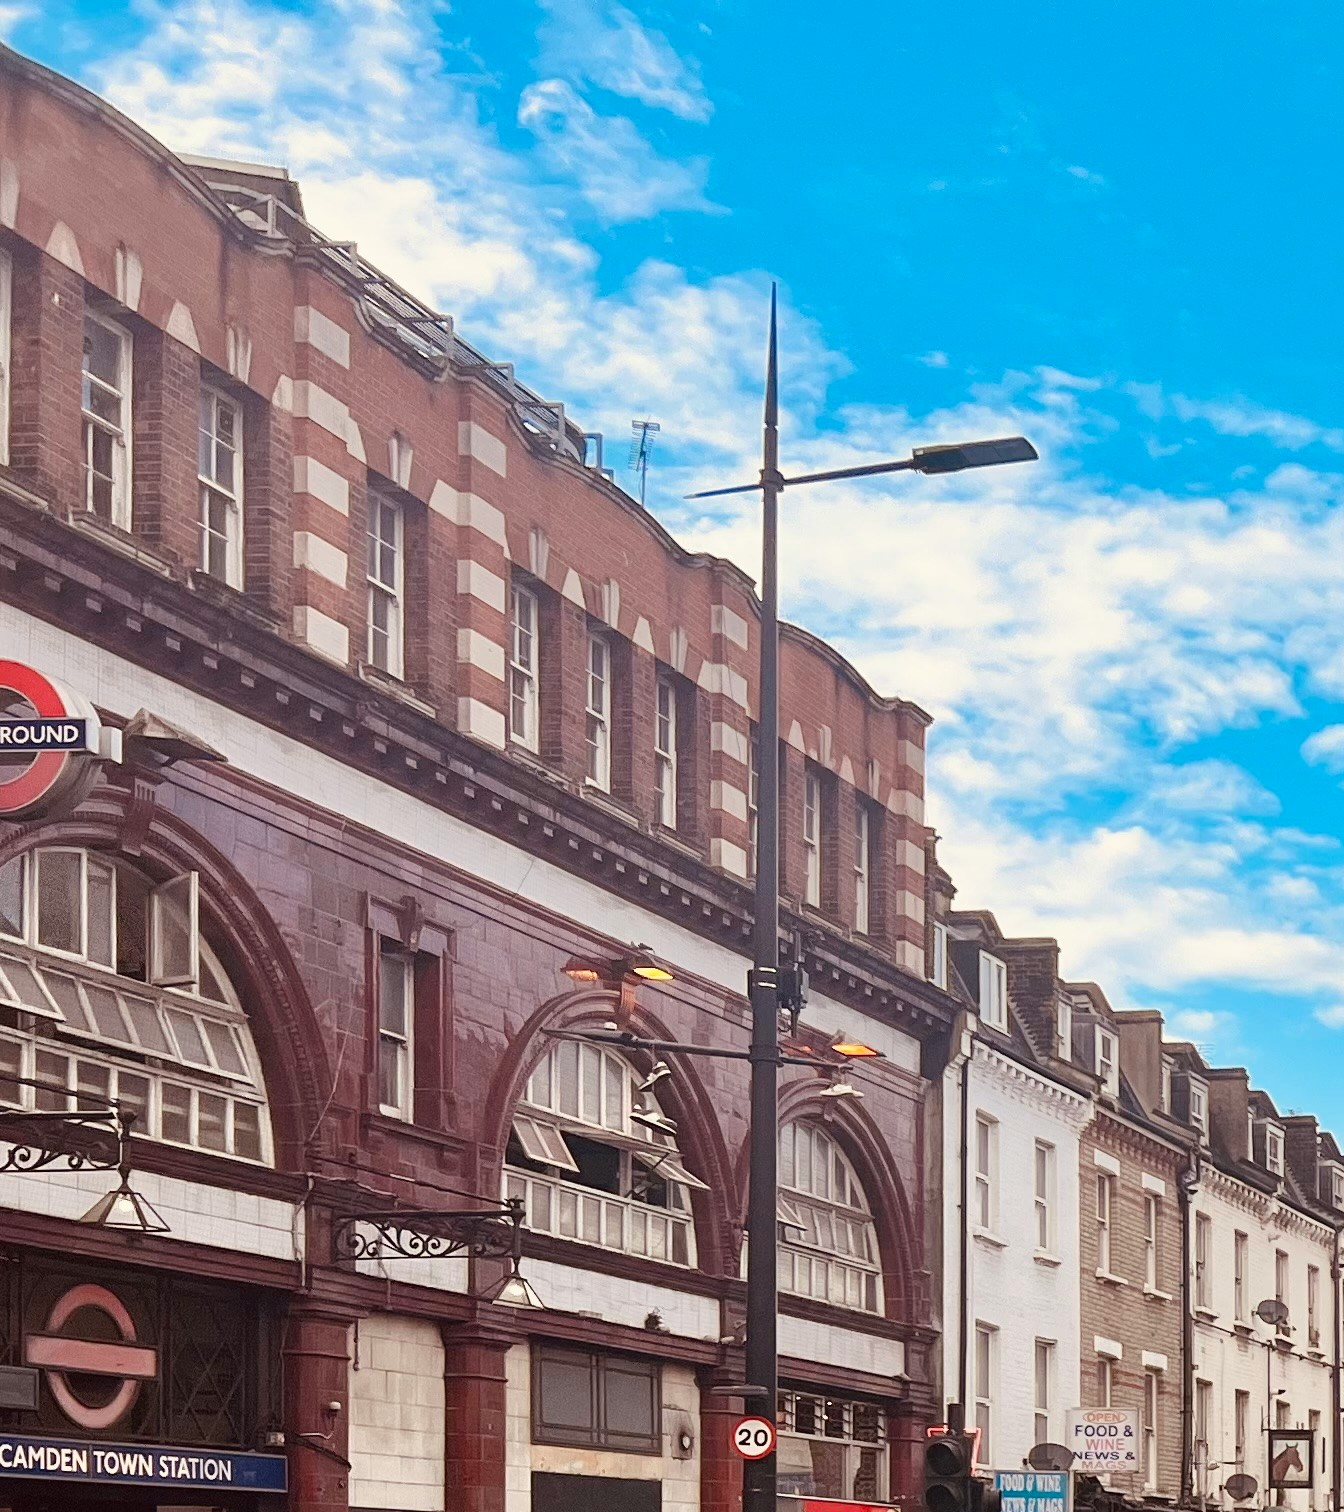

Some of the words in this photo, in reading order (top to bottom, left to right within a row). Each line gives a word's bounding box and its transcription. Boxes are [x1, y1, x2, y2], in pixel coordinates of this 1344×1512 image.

[0, 725, 79, 744] ROUND
[1086, 1411, 1121, 1422] OPEN
[738, 1428, 768, 1447] 20
[1075, 1425, 1118, 1437] FOOD
[1123, 1425, 1134, 1437] &
[1085, 1438, 1125, 1451] WINE
[0, 1443, 87, 1473] CAMDEN
[93, 1450, 153, 1477] TOWN
[159, 1457, 232, 1481] STATION
[1073, 1451, 1119, 1460] NEWS
[1124, 1451, 1135, 1460] &
[1081, 1460, 1127, 1470] MAGS
[1000, 1474, 1025, 1492] FOOD
[1026, 1474, 1034, 1493] &
[1036, 1474, 1061, 1493] WINE
